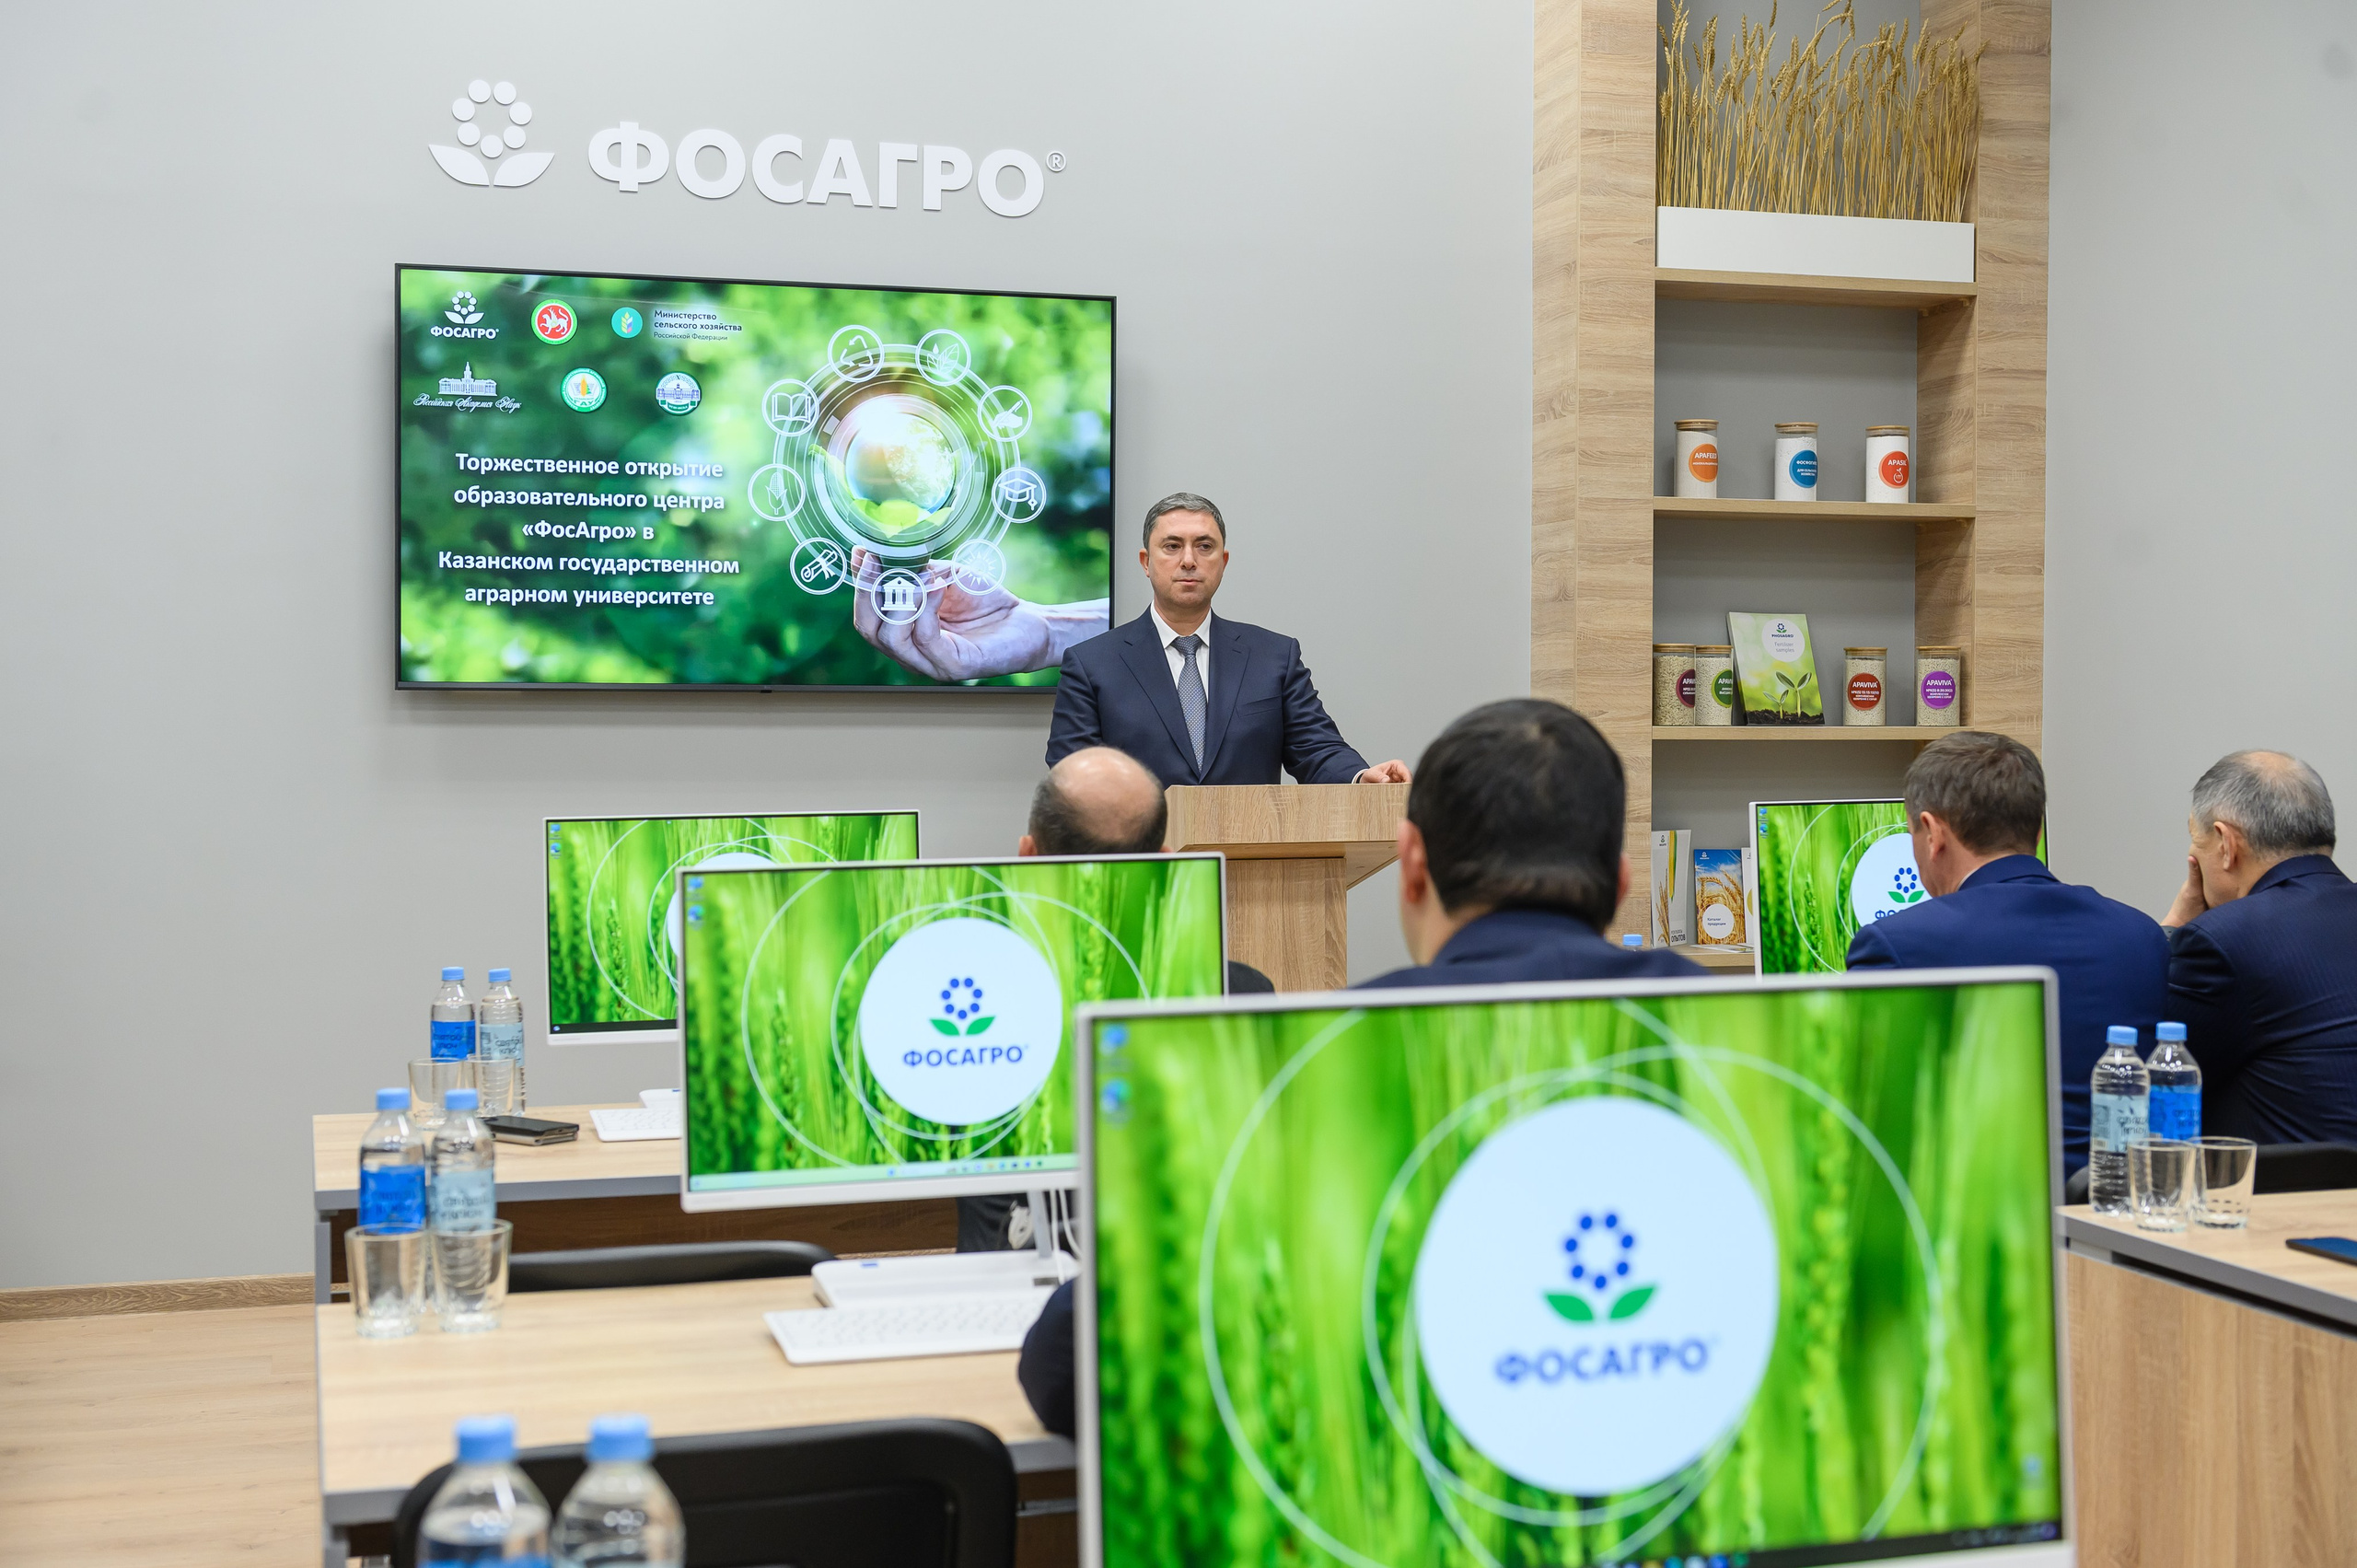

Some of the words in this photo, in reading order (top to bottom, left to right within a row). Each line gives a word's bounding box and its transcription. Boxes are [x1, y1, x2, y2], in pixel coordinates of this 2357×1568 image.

[654, 309, 717, 321] Министерство
[654, 321, 698, 330] сельского
[700, 322, 742, 331] хозяйства
[653, 331, 691, 340] Российской
[691, 332, 728, 342] Федерации
[455, 452, 620, 475] Торжественное
[624, 460, 724, 480] открытие
[453, 484, 647, 508] образовательного
[653, 494, 726, 513] центра
[521, 519, 637, 543] «ФосАгро»
[643, 525, 656, 540] в
[438, 551, 554, 571] Казанском
[559, 556, 740, 576] государственном
[464, 587, 568, 607] аграрном
[573, 589, 714, 608] университете
[902, 1045, 1024, 1068] ФОСАГРО
[1493, 1336, 1711, 1388] ФОСАГРО
